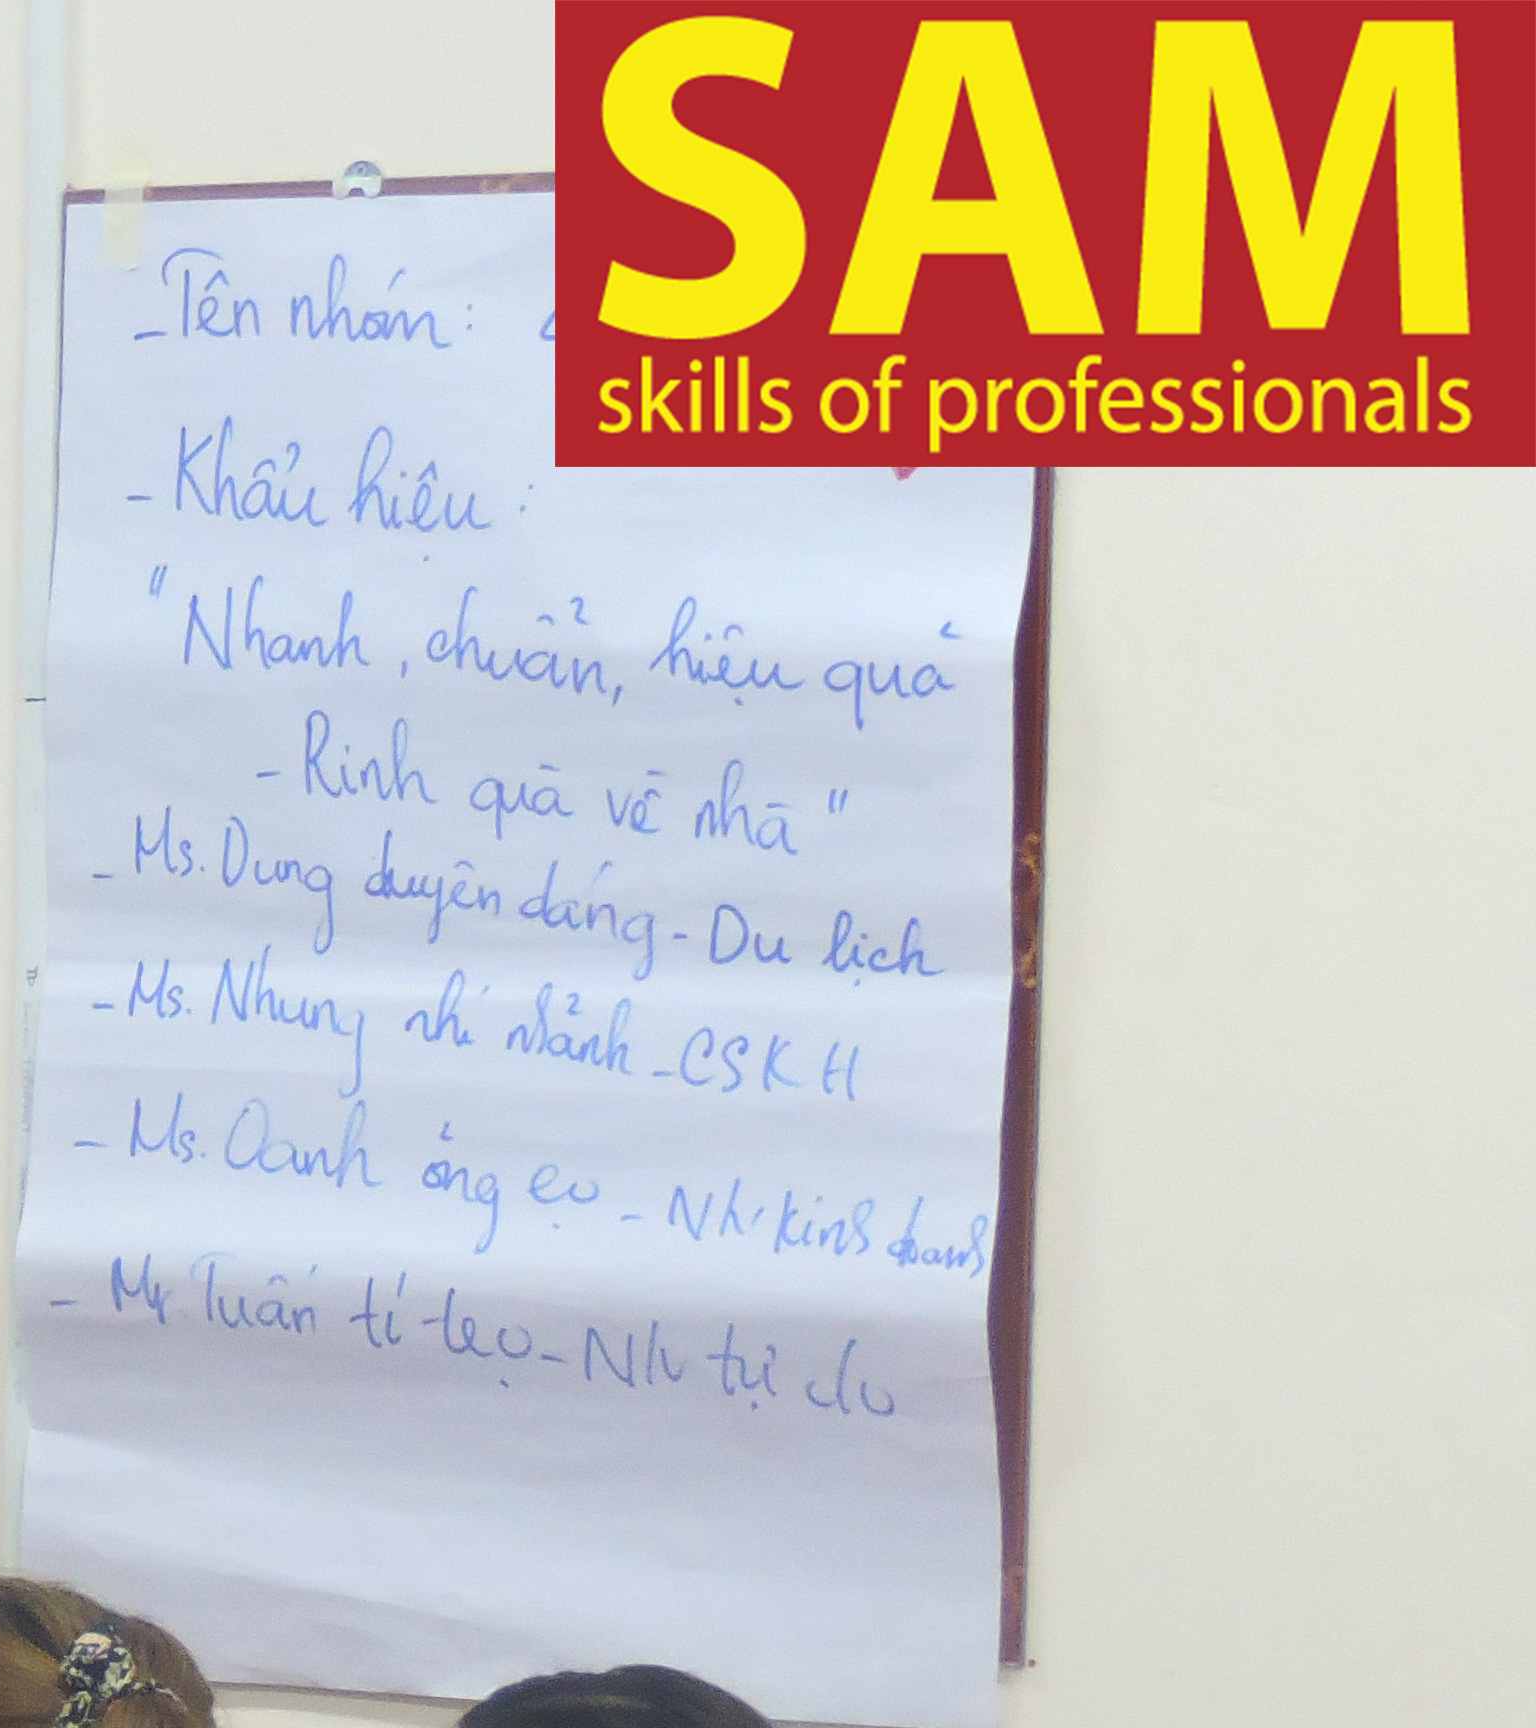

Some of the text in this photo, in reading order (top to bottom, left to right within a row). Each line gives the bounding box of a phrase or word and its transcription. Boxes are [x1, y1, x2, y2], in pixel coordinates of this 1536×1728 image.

[162, 247, 260, 338] Tên
[649, 596, 805, 706] hiệu
[823, 620, 961, 730] quả
[304, 709, 437, 804] Rinh
[709, 903, 791, 965] Du
[823, 910, 944, 986] lịch
[211, 943, 364, 1099] Nhung
[227, 1097, 382, 1188] Oanh
